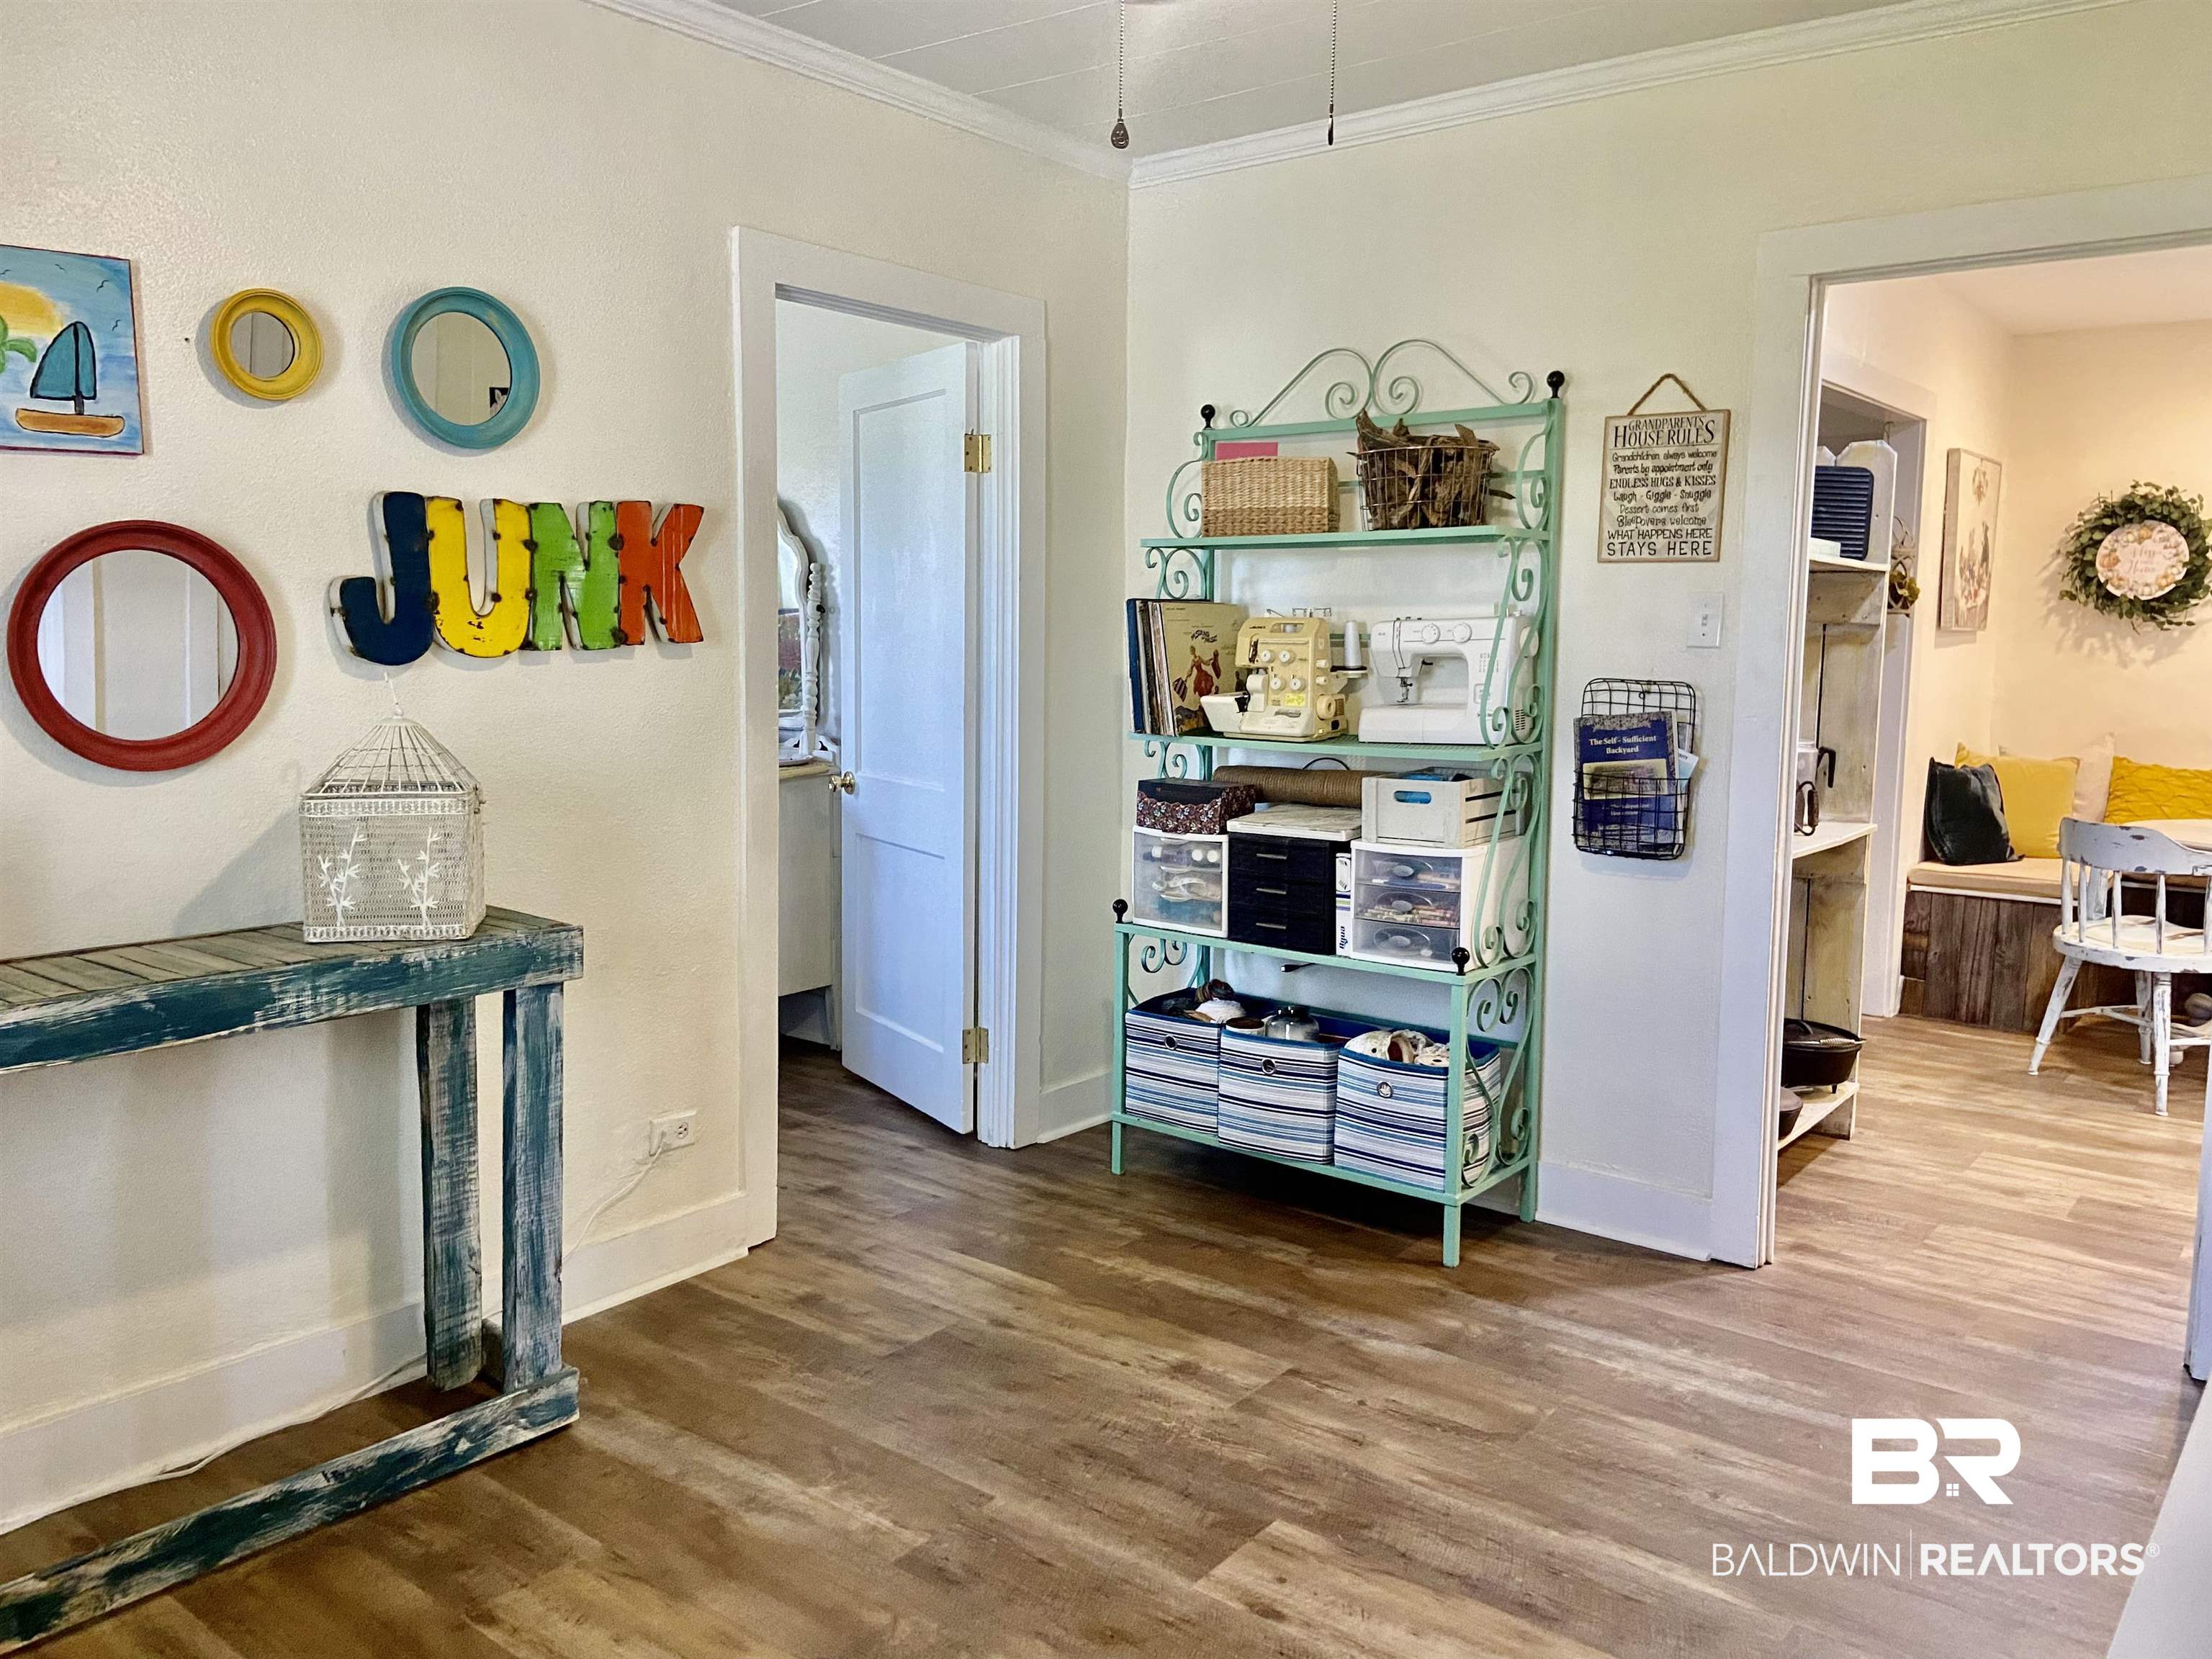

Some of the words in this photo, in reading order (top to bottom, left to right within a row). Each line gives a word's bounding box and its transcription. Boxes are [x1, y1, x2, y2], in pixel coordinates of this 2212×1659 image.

[1614, 425, 1663, 448] HOUSE
[1667, 420, 1715, 445] RULES
[1612, 451, 1660, 462] Grandchildren
[1663, 450, 1686, 462] always
[1687, 448, 1717, 459] welcome
[1613, 464, 1640, 474] Parents
[1651, 462, 1695, 476] appointment
[1609, 477, 1649, 489] ENDLESS
[1650, 476, 1674, 487] HUGS
[1675, 476, 1682, 487] &
[1684, 475, 1717, 487] KISSES
[1614, 491, 1637, 503] Laugh
[1680, 488, 1712, 503] Snuggle
[1619, 504, 1650, 514] Dessert
[1652, 504, 1678, 513] comes
[1681, 503, 1699, 513] first
[1670, 514, 1707, 526] welcome
[1607, 530, 1635, 540] WHAT
[1637, 529, 1683, 540] HAPPENS
[1686, 528, 1713, 539] HERE
[1606, 541, 1657, 557] STAYS
[1667, 541, 1712, 556] HERE
[329, 491, 704, 665] JUNK
[1606, 746, 1640, 755] Backyard
